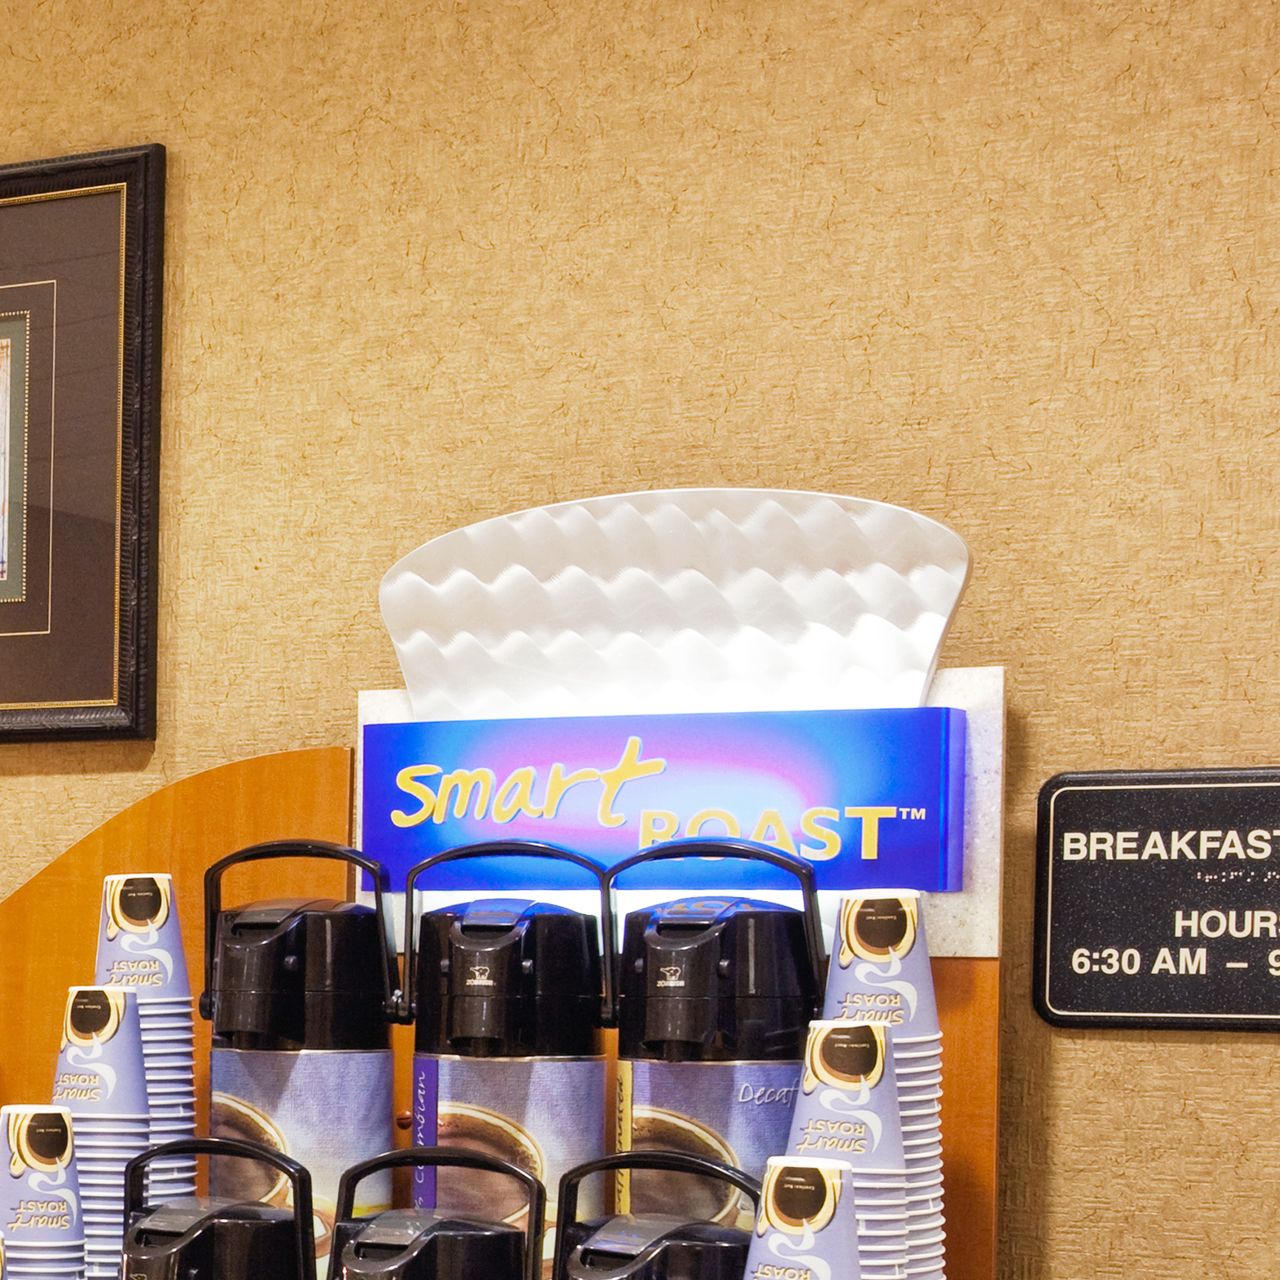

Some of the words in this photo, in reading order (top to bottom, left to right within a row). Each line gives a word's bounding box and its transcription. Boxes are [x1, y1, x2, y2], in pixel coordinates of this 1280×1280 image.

[1174, 910, 1280, 939] HOUR
[110, 960, 160, 973] ROAST
[1071, 948, 1140, 975] 6:30
[1151, 947, 1207, 975] AM
[843, 993, 901, 1006] ROAST
[807, 1118, 867, 1135] ROAST
[14, 1199, 68, 1213] ROAST
